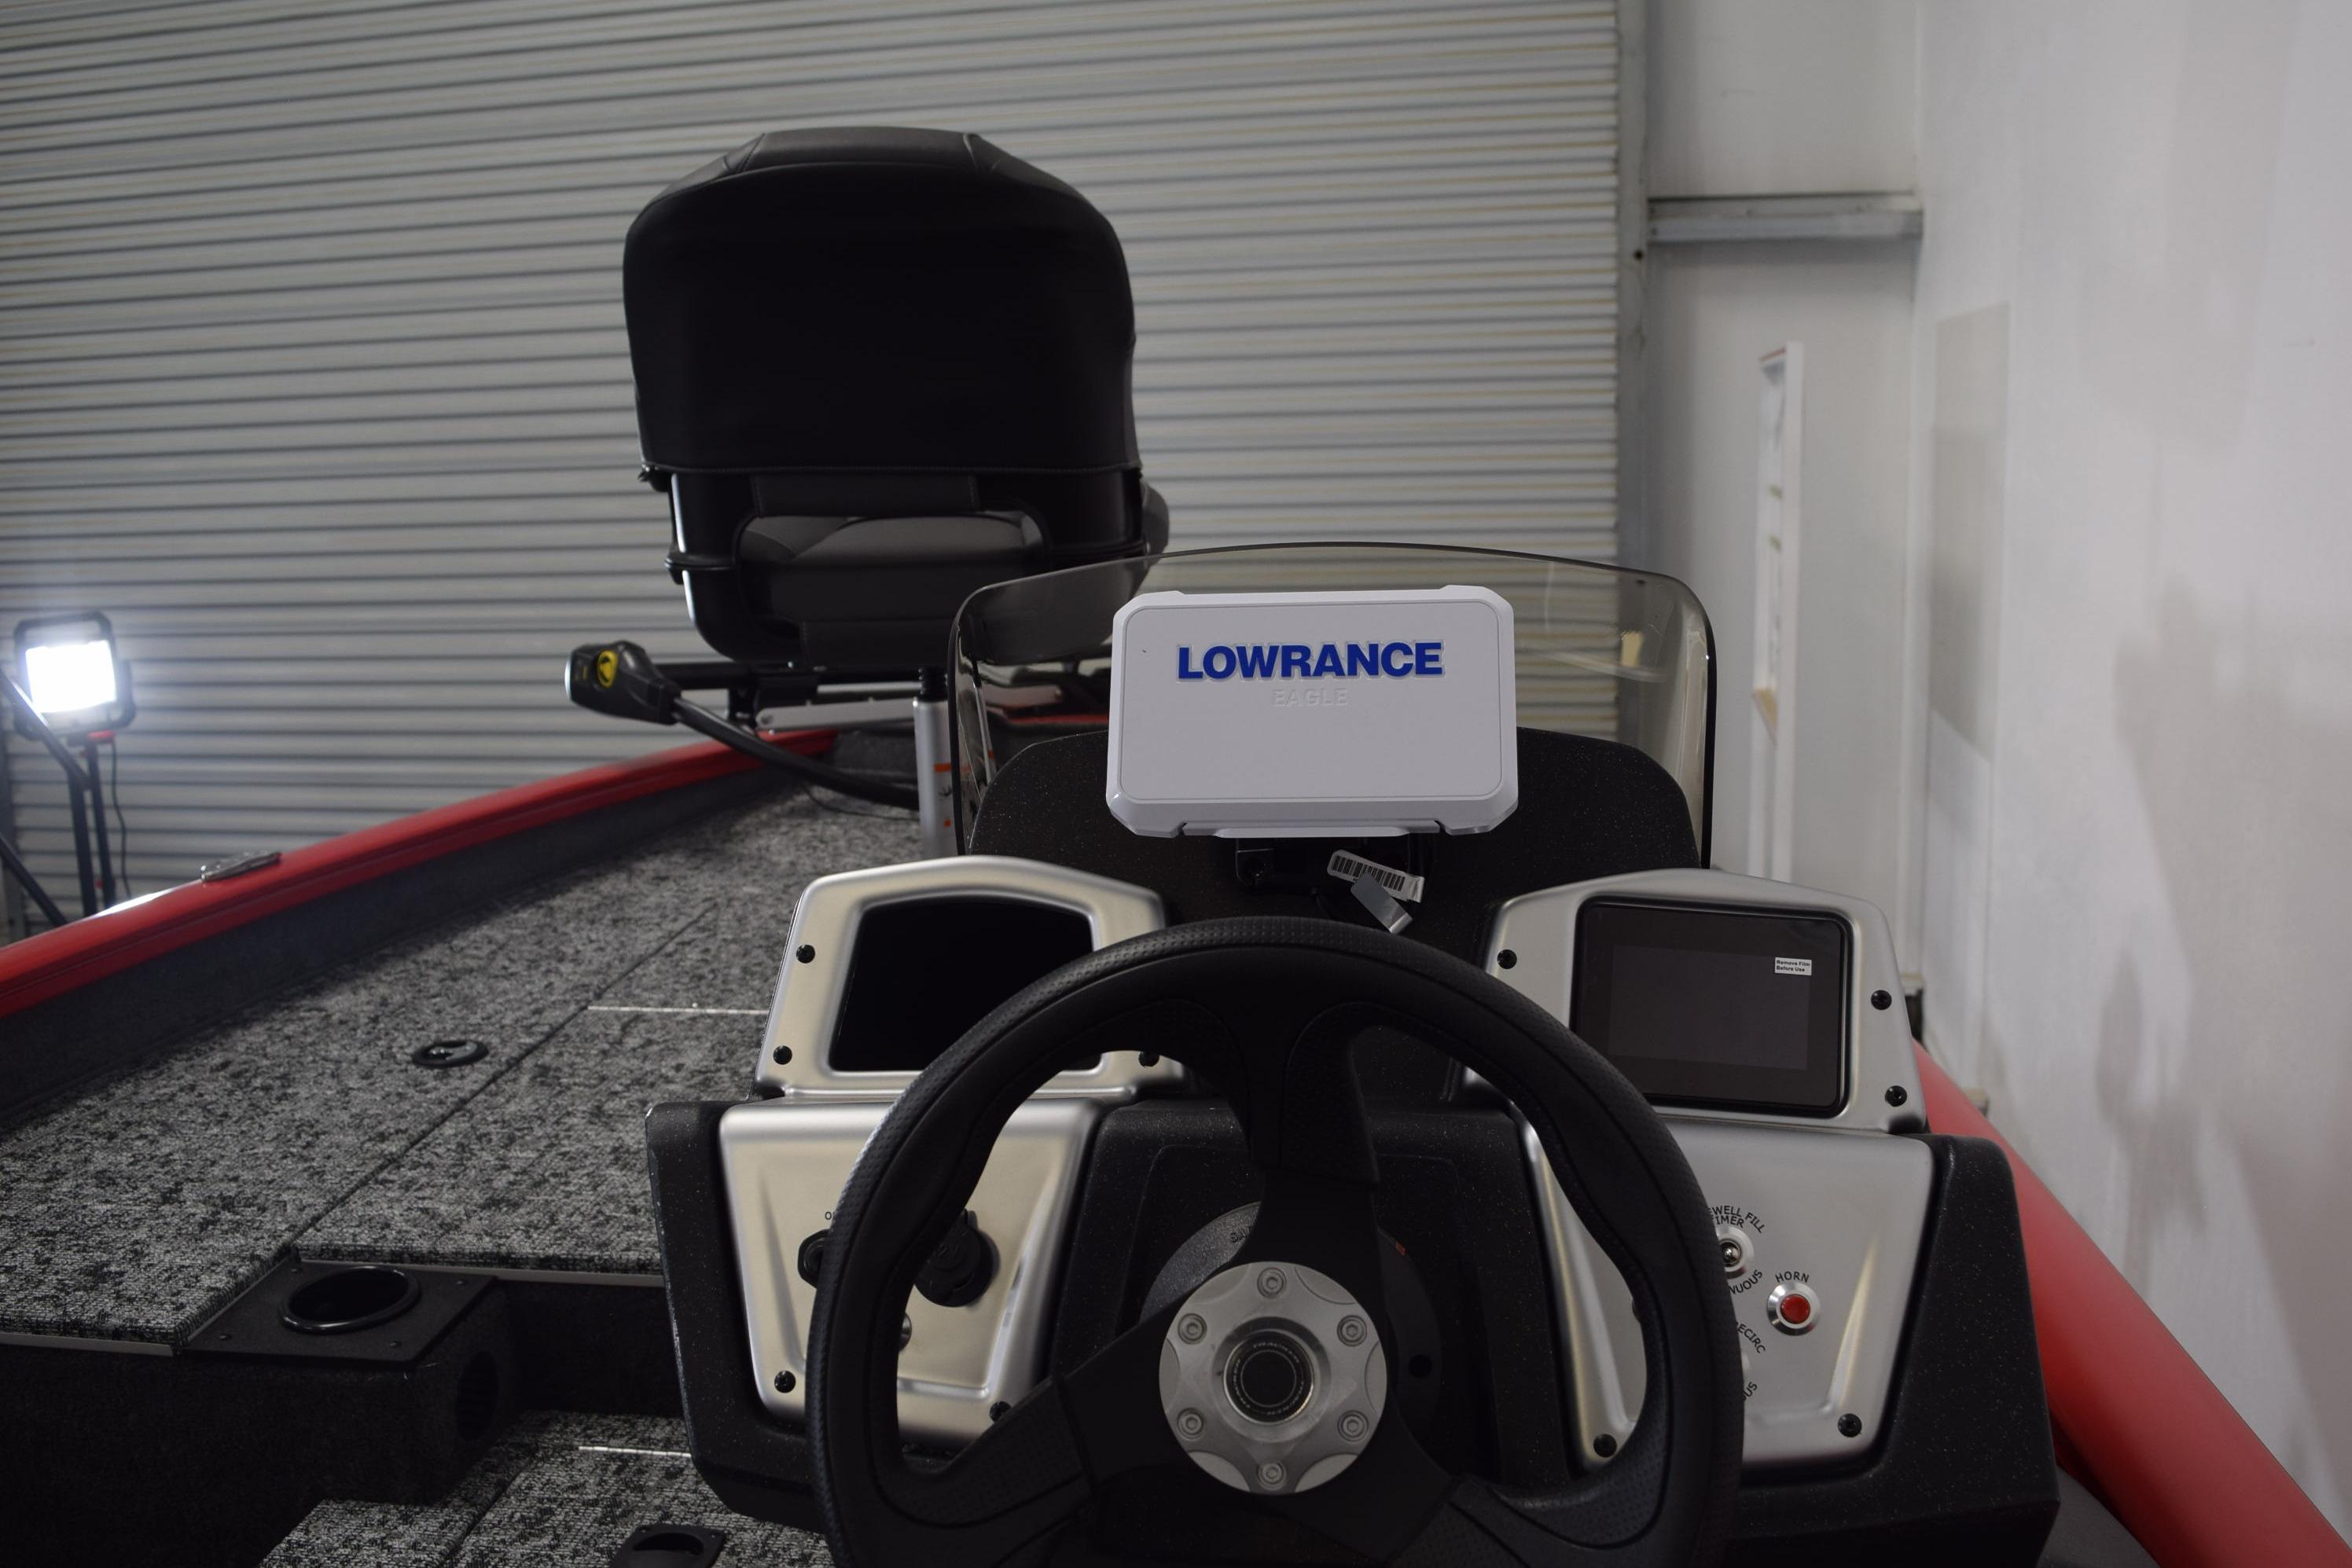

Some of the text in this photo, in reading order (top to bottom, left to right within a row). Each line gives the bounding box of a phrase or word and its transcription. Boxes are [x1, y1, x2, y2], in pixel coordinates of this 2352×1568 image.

[1178, 641, 1442, 679] LOWRANCE
[1273, 687, 1349, 707] EAGLE
[1711, 1214, 1744, 1228] IMER
[1745, 1212, 1765, 1233] FILL
[1775, 1271, 1810, 1283] HORN
[1736, 1323, 1766, 1353] ECIRC
